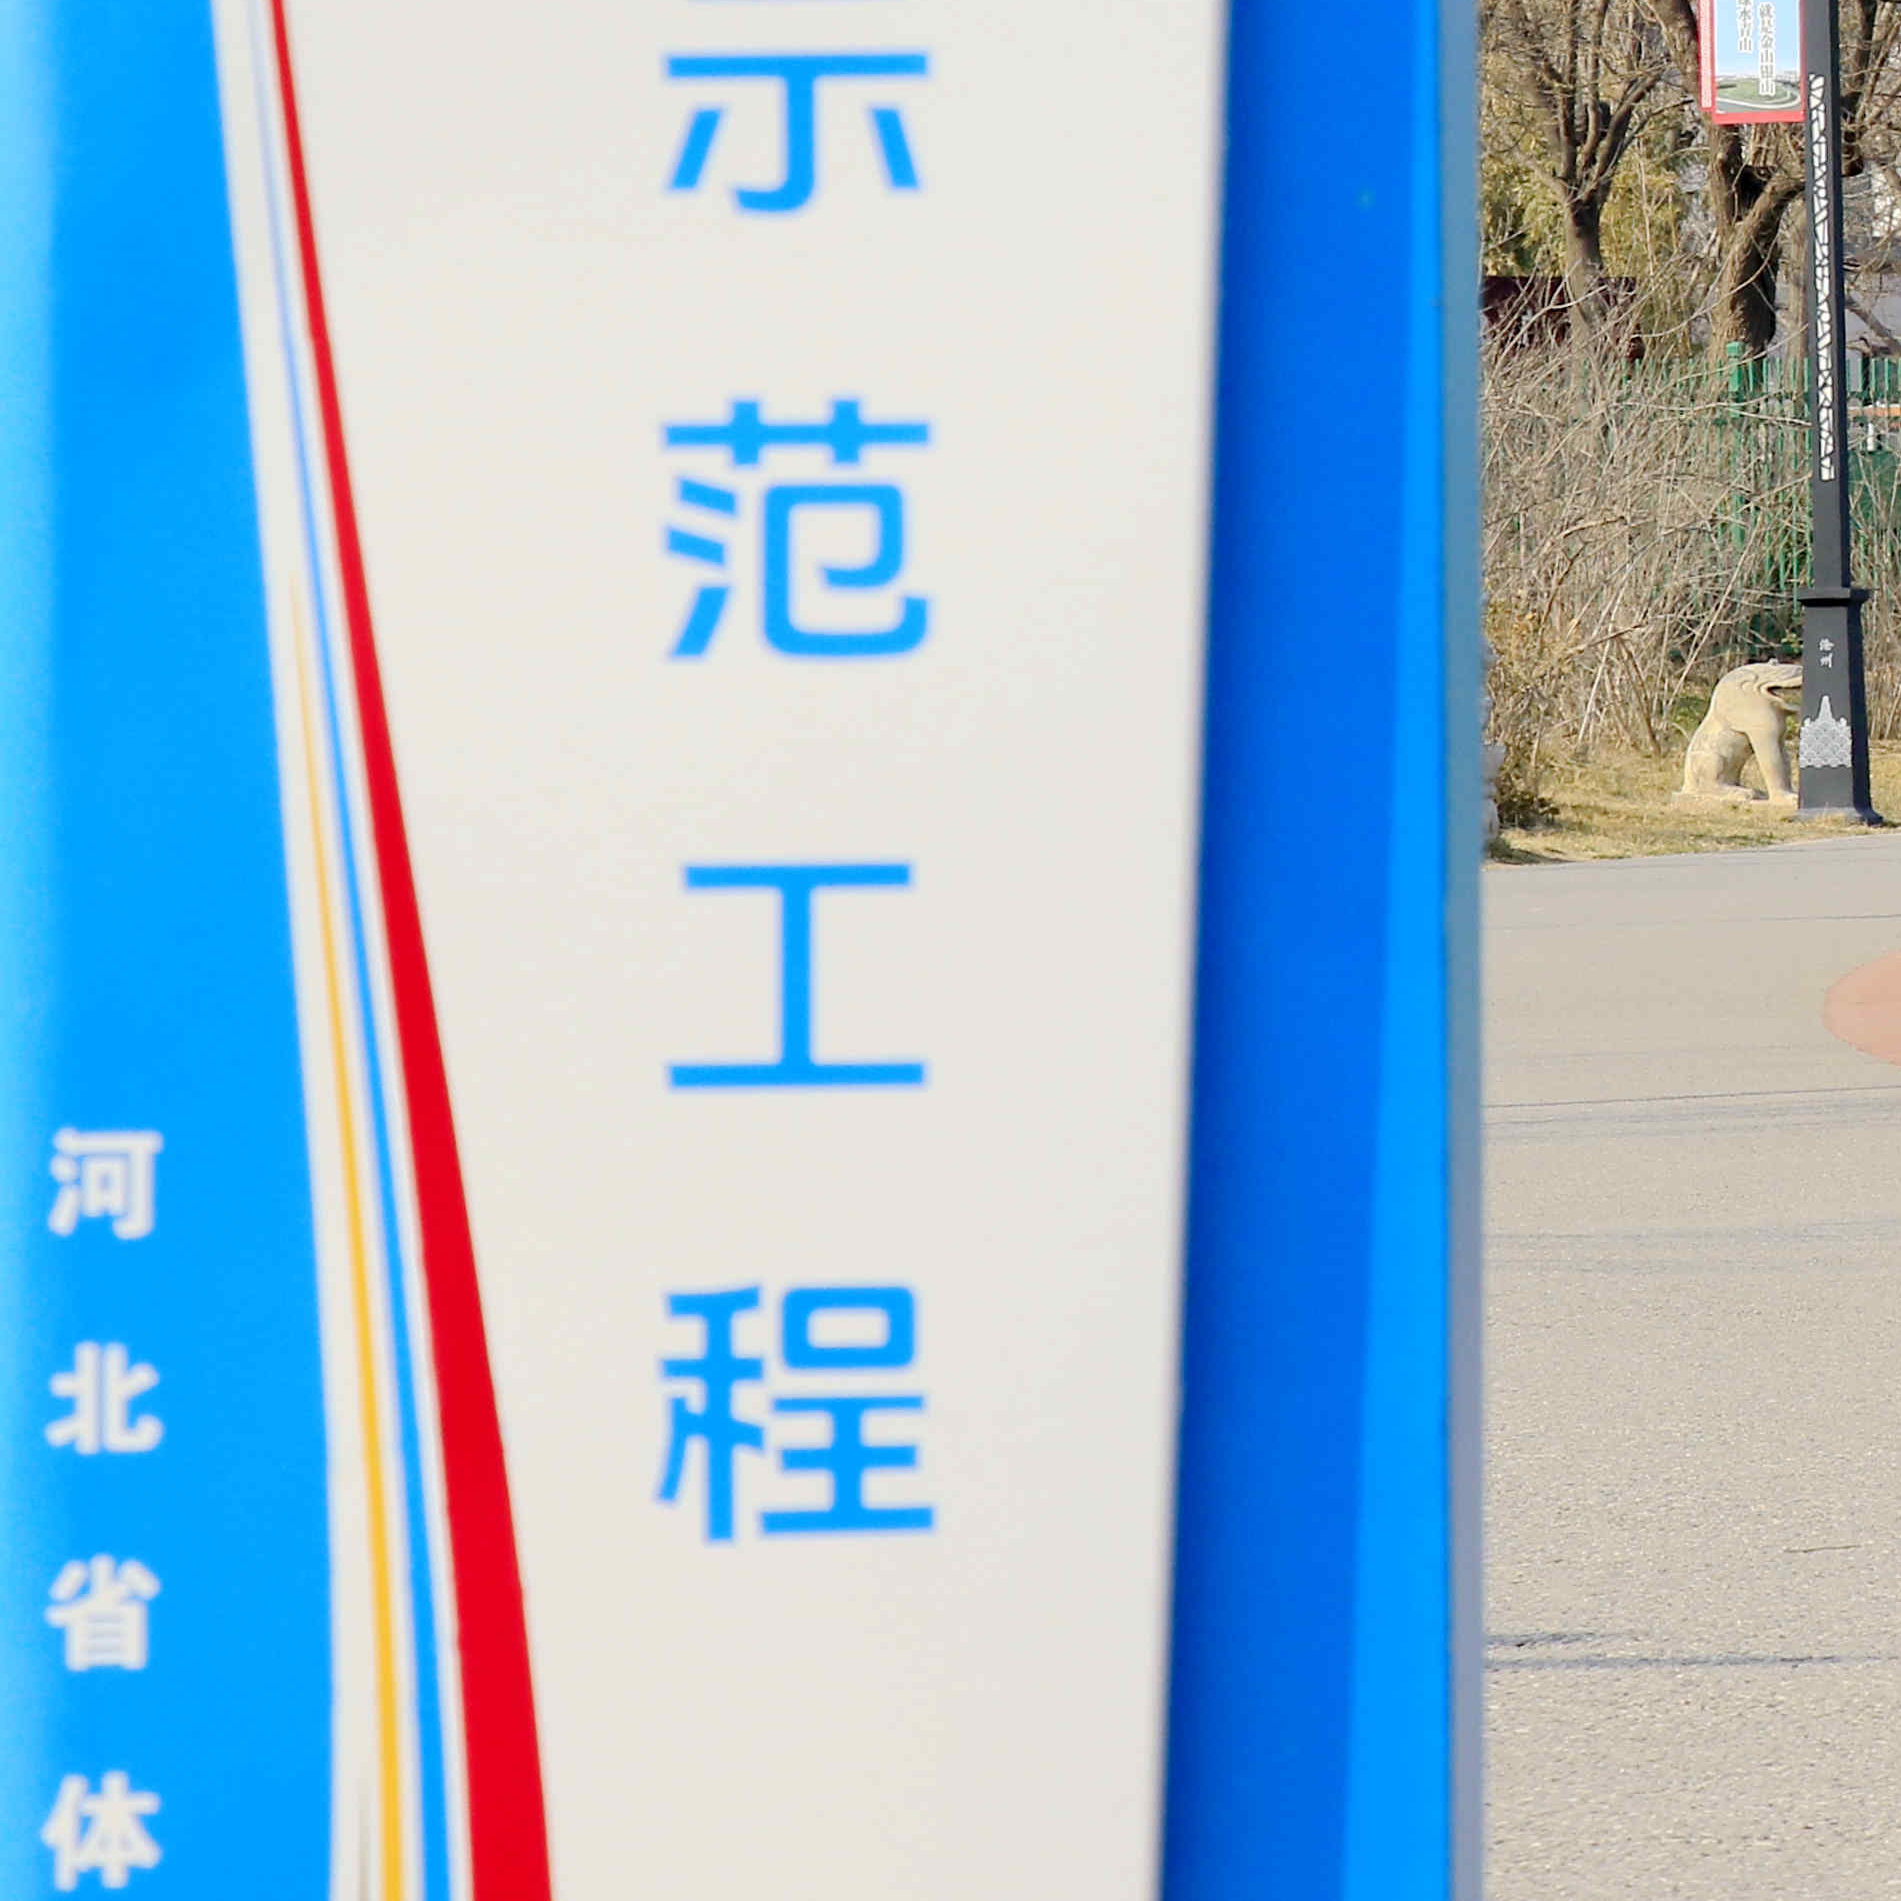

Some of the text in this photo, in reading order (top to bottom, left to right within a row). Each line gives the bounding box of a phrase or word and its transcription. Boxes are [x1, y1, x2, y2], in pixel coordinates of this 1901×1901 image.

[1758, 2, 1775, 96] 就是金山银山
[41, 1126, 163, 1892] 河北省体
